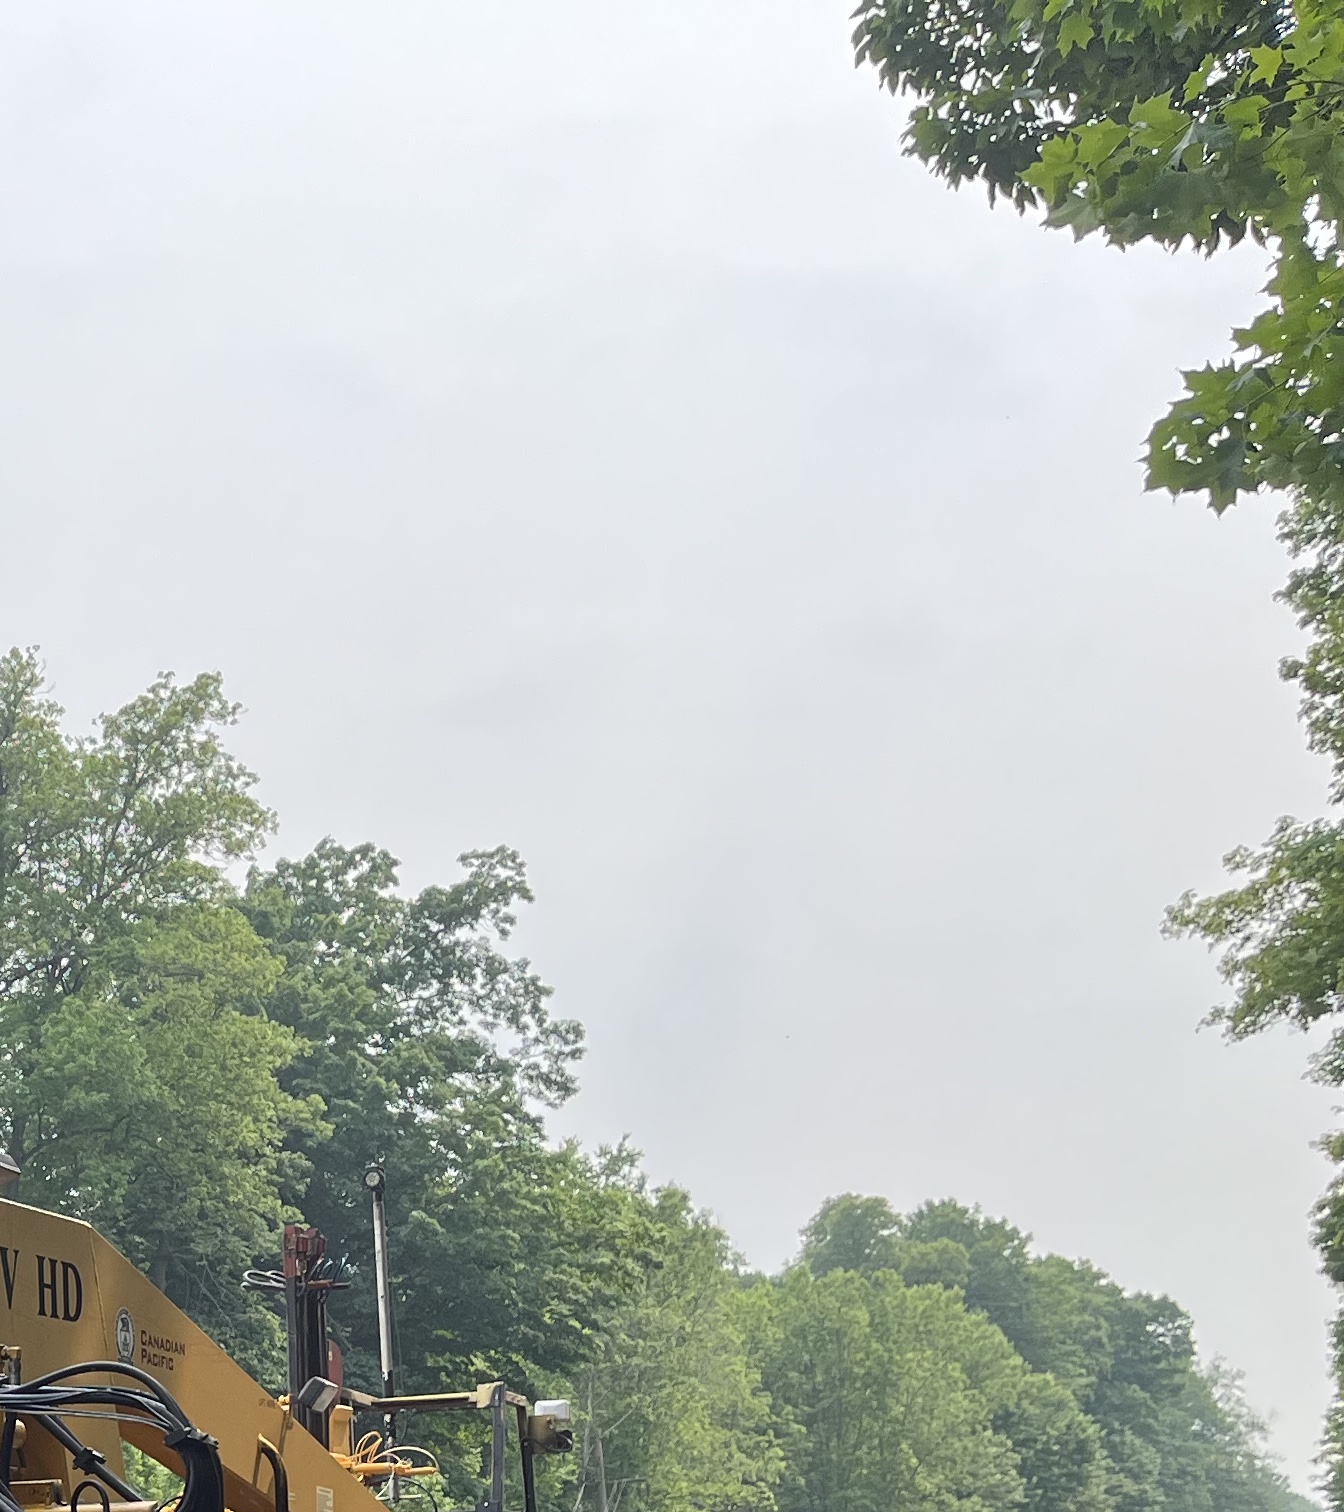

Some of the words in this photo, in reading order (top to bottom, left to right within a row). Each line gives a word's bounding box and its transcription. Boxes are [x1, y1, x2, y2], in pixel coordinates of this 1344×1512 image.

[35, 1254, 83, 1323] HD
[140, 1329, 186, 1356] CANADIAN
[140, 1347, 175, 1371] PACIFIC
